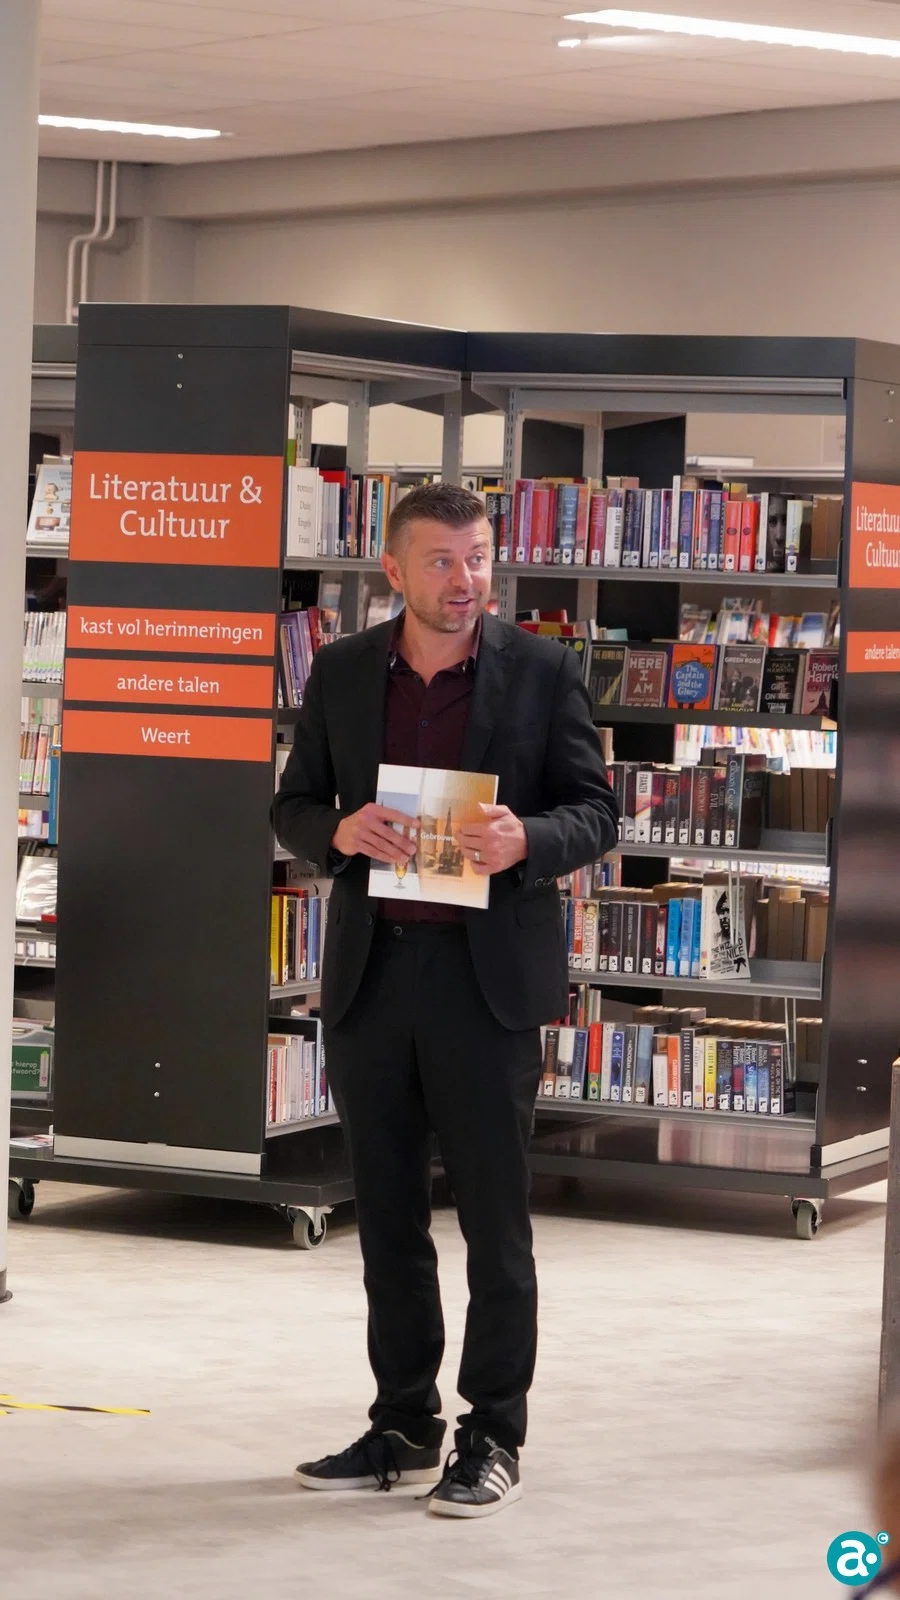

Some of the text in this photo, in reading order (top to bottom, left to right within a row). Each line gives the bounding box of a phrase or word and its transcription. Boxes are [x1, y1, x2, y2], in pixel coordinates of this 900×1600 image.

[89, 473, 262, 504] Literatuur &
[119, 508, 230, 539] Cultuur
[855, 505, 900, 533] Literatuu
[80, 617, 263, 644] kast vol herinneringen
[864, 644, 884, 660] andere
[629, 657, 663, 669] HERE
[686, 664, 698, 673] The
[812, 662, 838, 671] Robert
[640, 669, 649, 681] I
[675, 670, 705, 680] Captain
[116, 674, 220, 694] andere talen
[633, 682, 653, 694] AM
[677, 680, 702, 689] and the
[677, 686, 699, 698] Glory
[140, 727, 191, 745] Weert
[709, 793, 719, 810] EVIL
[584, 912, 595, 954] GODDARD
[720, 937, 744, 951] WIZD
[726, 945, 744, 959] NILE
